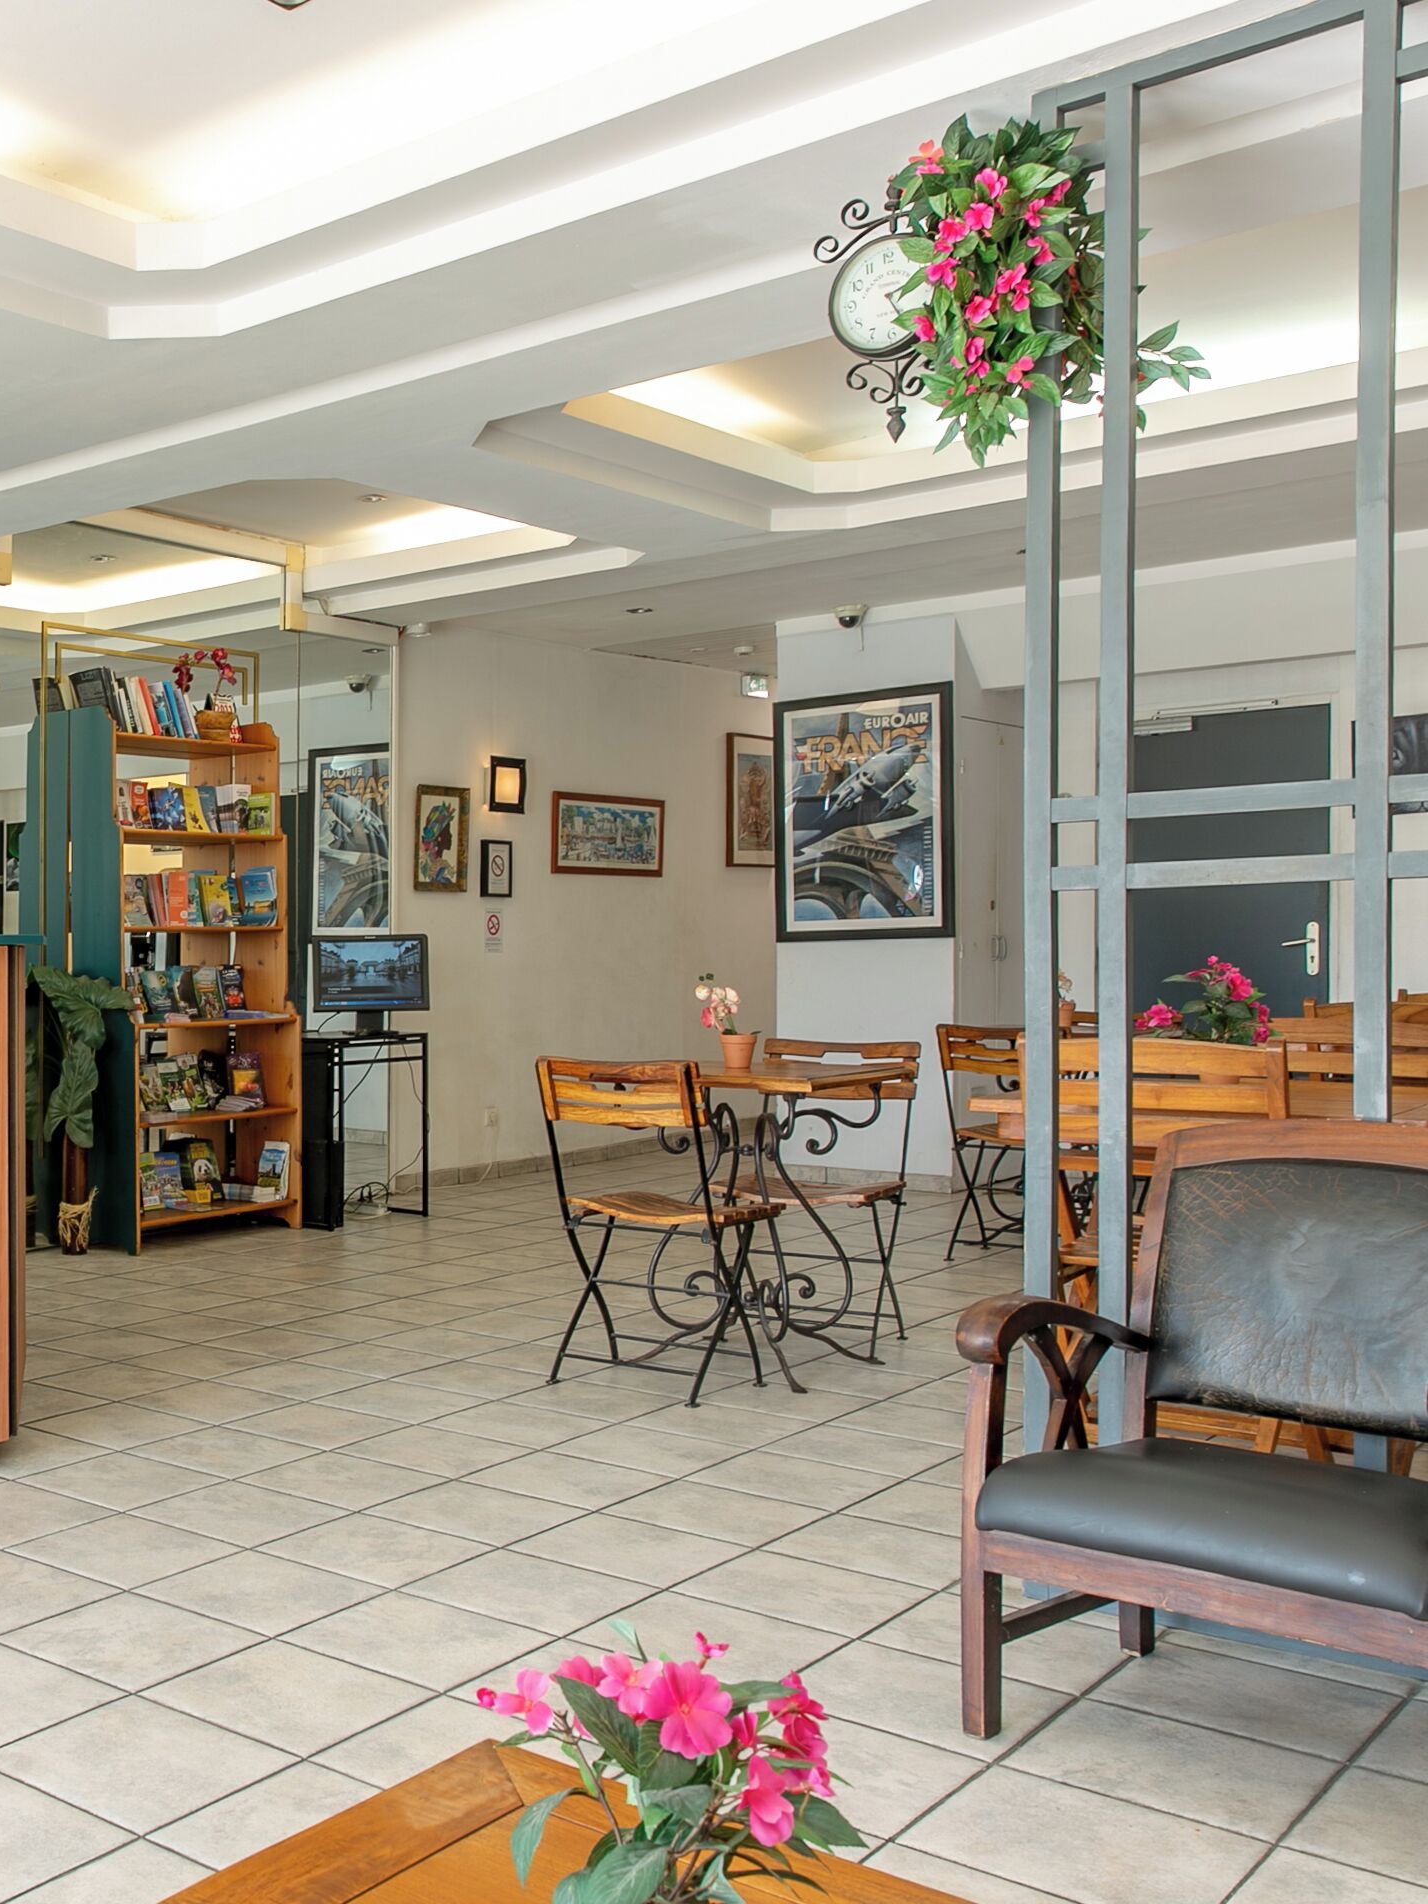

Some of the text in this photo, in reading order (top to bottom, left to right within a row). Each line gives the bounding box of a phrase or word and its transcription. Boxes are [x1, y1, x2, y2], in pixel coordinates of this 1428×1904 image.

[883, 251, 894, 264] 12
[865, 262, 874, 275] 11
[852, 279, 864, 292] 10
[847, 300, 857, 313] 9
[854, 318, 863, 329] 8
[869, 327, 876, 340] 7
[887, 328, 897, 340] 6
[863, 711, 929, 730] EUROAIR
[796, 725, 929, 774] FRANCE
